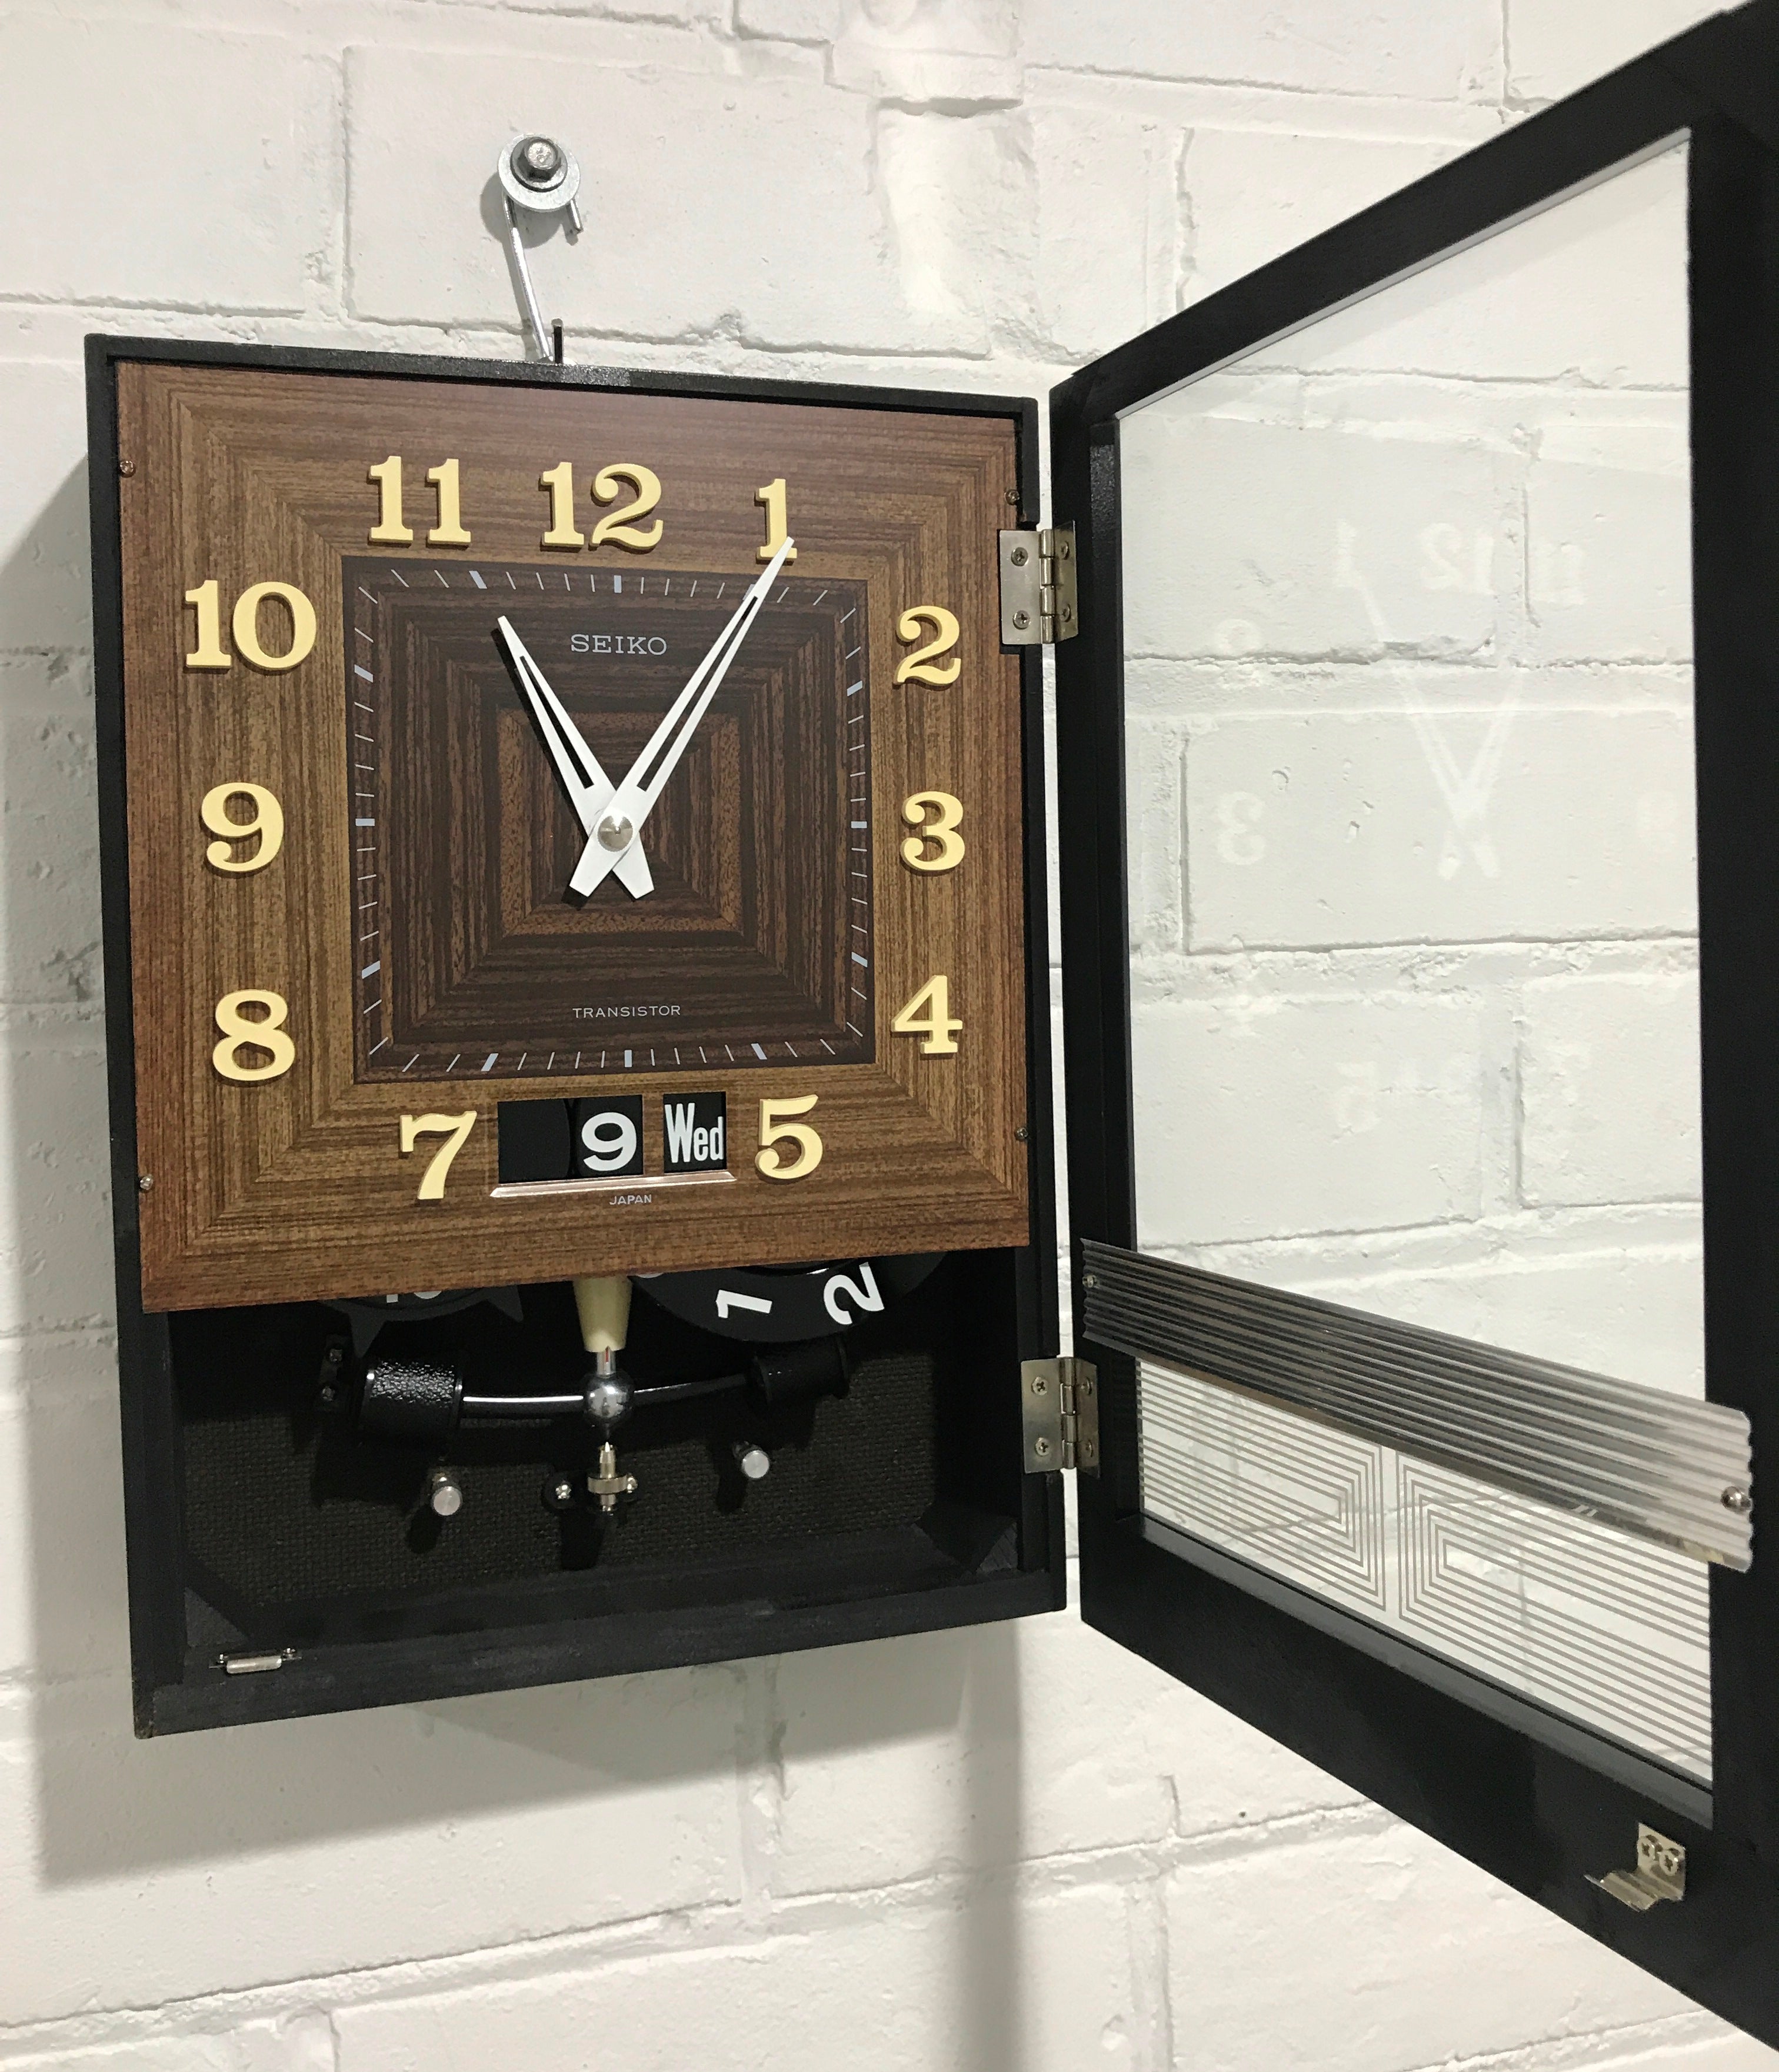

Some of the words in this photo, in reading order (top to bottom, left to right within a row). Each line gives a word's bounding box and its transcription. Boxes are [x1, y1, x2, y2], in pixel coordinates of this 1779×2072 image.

[368, 455, 472, 544] 11
[540, 461, 665, 549] 12
[755, 478, 798, 564] 1
[184, 579, 318, 670] 10
[570, 633, 668, 655] SEIKO
[894, 605, 962, 686] 2
[201, 781, 285, 873] 9
[900, 791, 965, 871] 3
[212, 988, 296, 1082] 8
[572, 1005, 681, 1018] TRANSISTOR
[891, 974, 964, 1055] 4
[399, 1110, 478, 1202] 7
[581, 1111, 637, 1172] 9
[664, 1102, 724, 1164] Wed
[754, 1094, 824, 1180] 5
[609, 1194, 652, 1205] JAPAN
[715, 1289, 773, 1319] 1
[823, 1261, 885, 1325] 2
